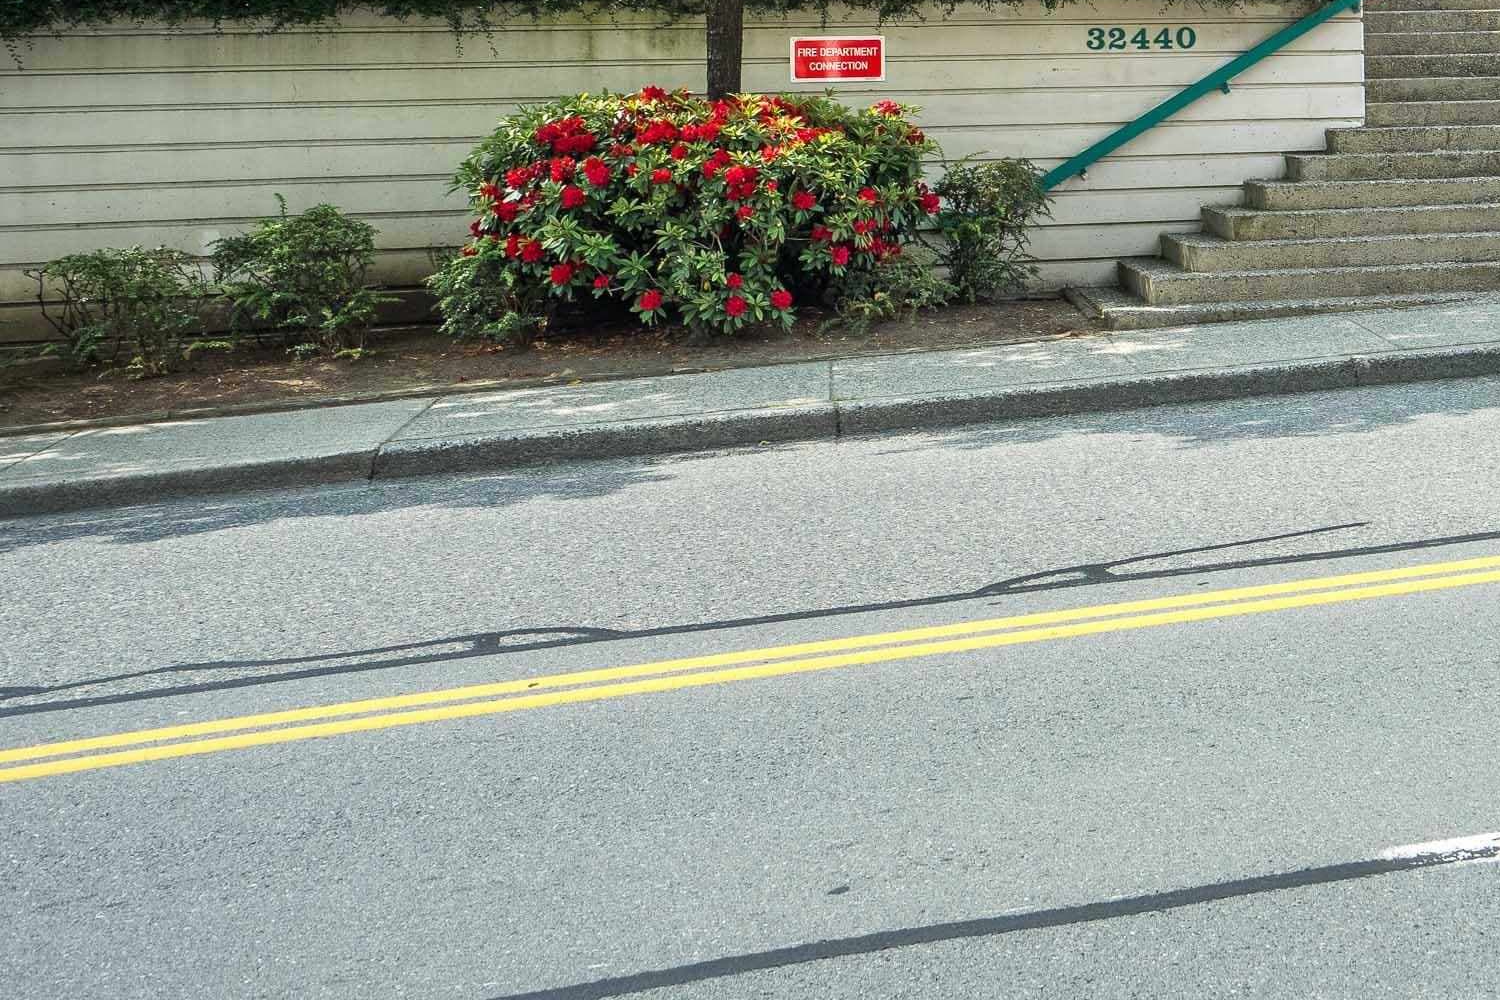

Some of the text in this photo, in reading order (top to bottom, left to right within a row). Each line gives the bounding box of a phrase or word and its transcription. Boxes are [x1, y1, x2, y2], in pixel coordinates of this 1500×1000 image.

[1086, 26, 1197, 50] 32440
[797, 46, 878, 57] FIRE DEPARTMENT
[809, 61, 868, 71] CONNECTION
